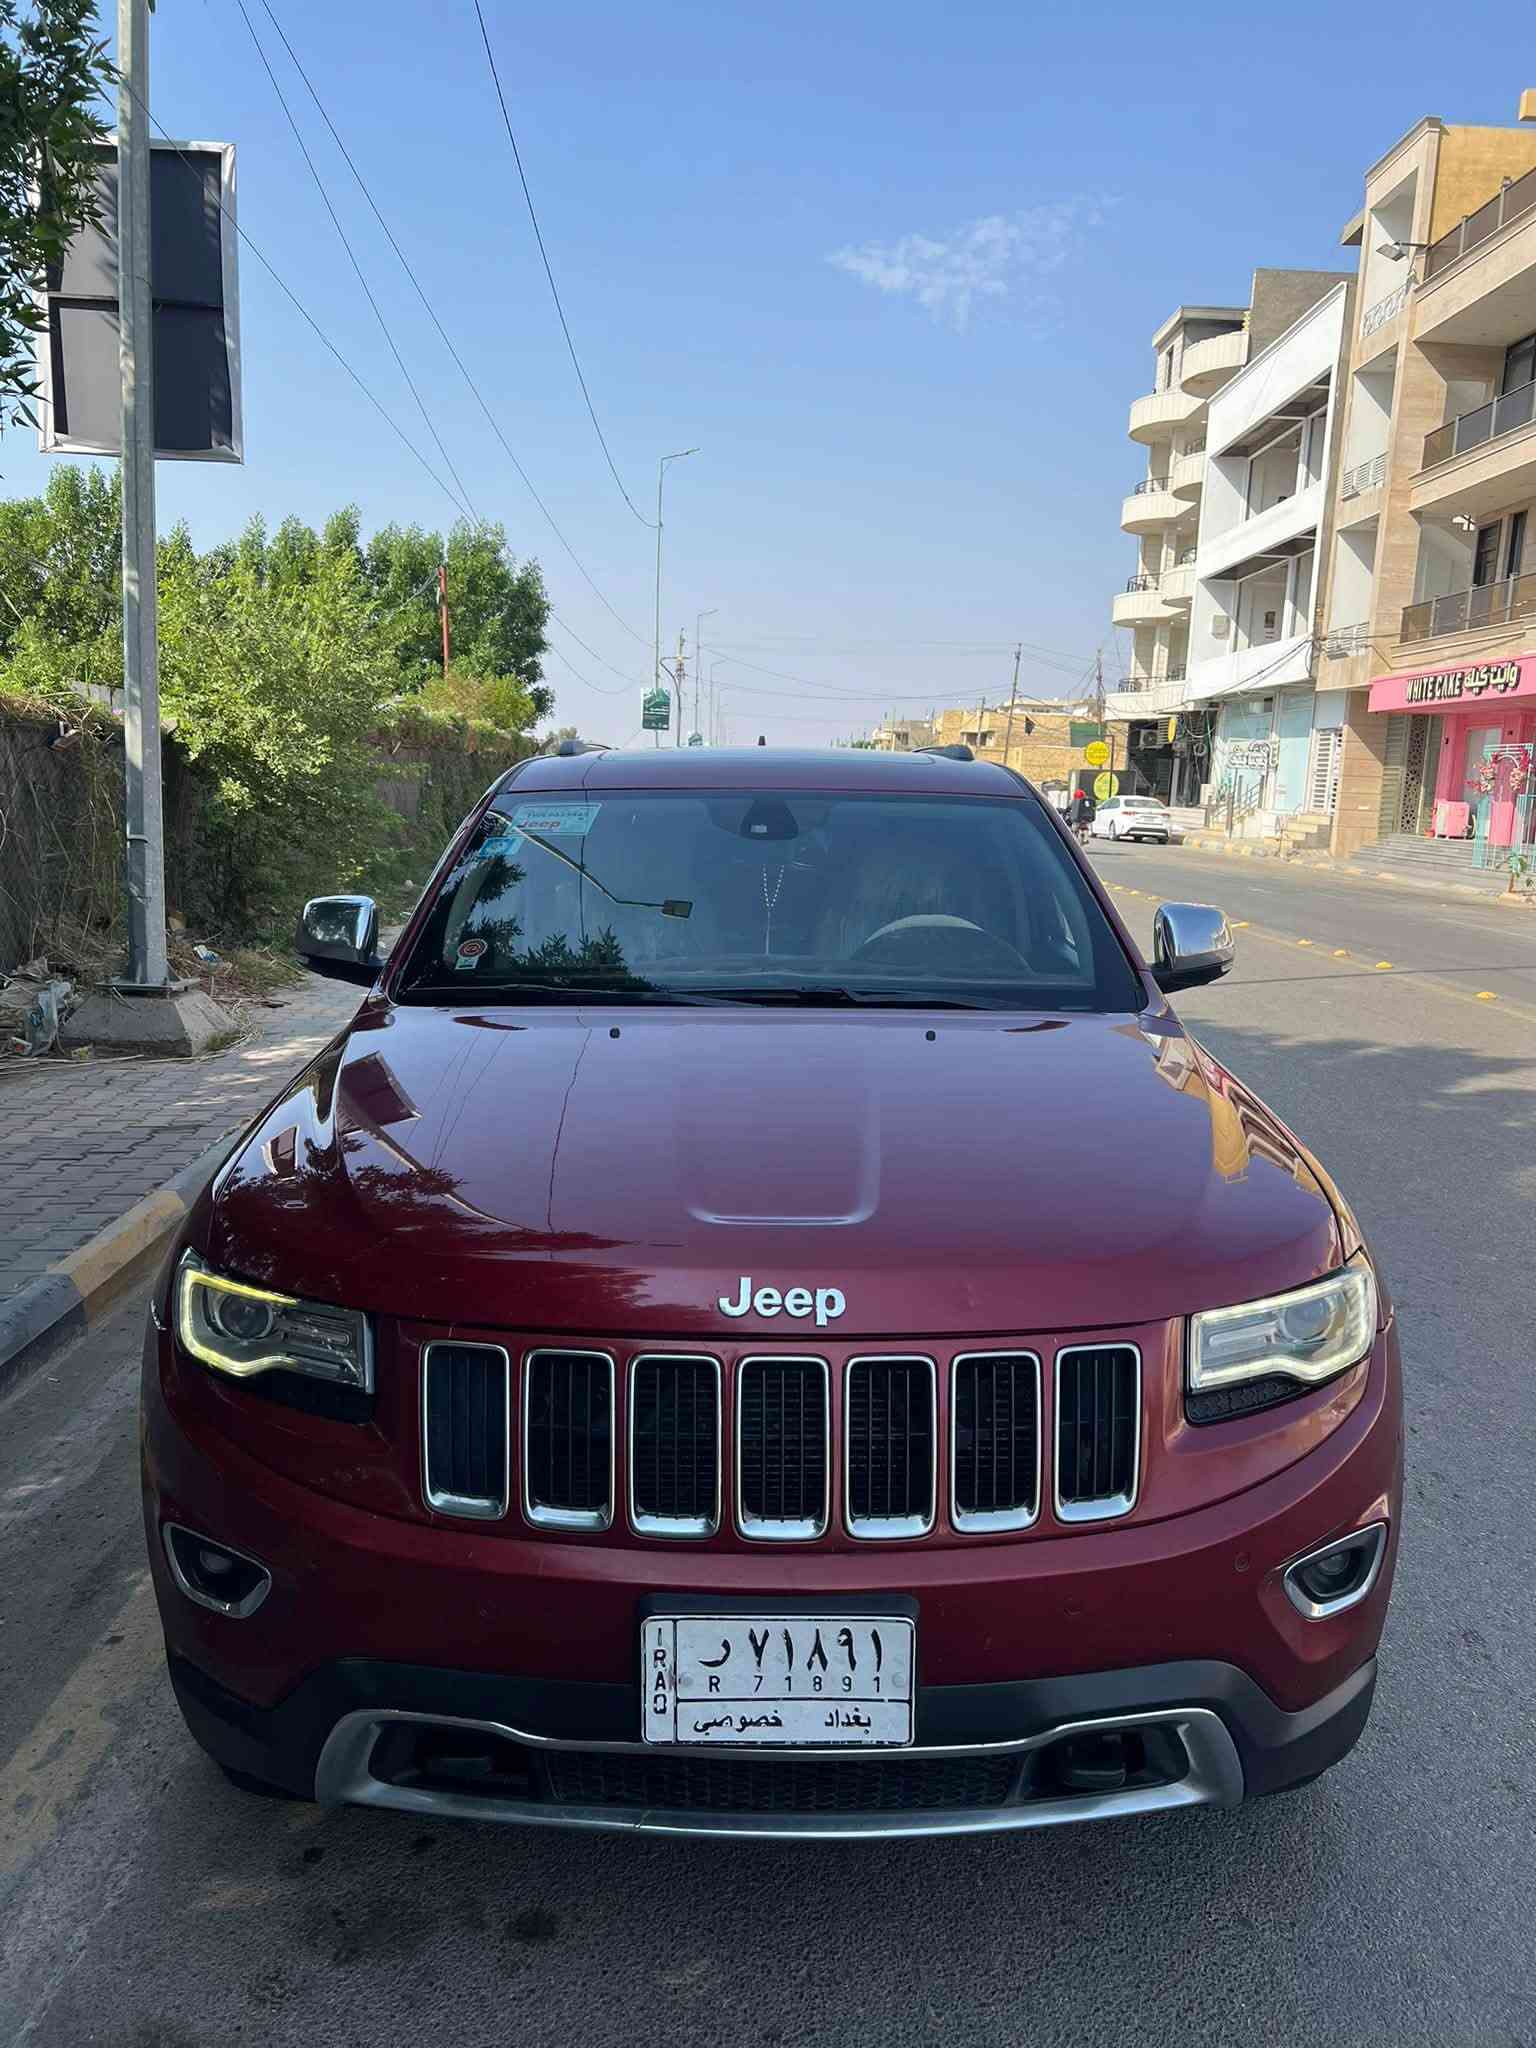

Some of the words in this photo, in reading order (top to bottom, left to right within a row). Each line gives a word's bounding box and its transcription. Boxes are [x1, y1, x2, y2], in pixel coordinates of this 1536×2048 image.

[1407, 676, 1434, 702] WHITE
[1435, 672, 1463, 699] CAKE
[1464, 666, 1489, 694] كيك
[1490, 662, 1519, 693] وايت
[718, 1276, 847, 1327] Jeep
[653, 1627, 668, 1715] IRAQ
[693, 1709, 784, 1736] خصوصي
[824, 1708, 872, 1735] بغداد
